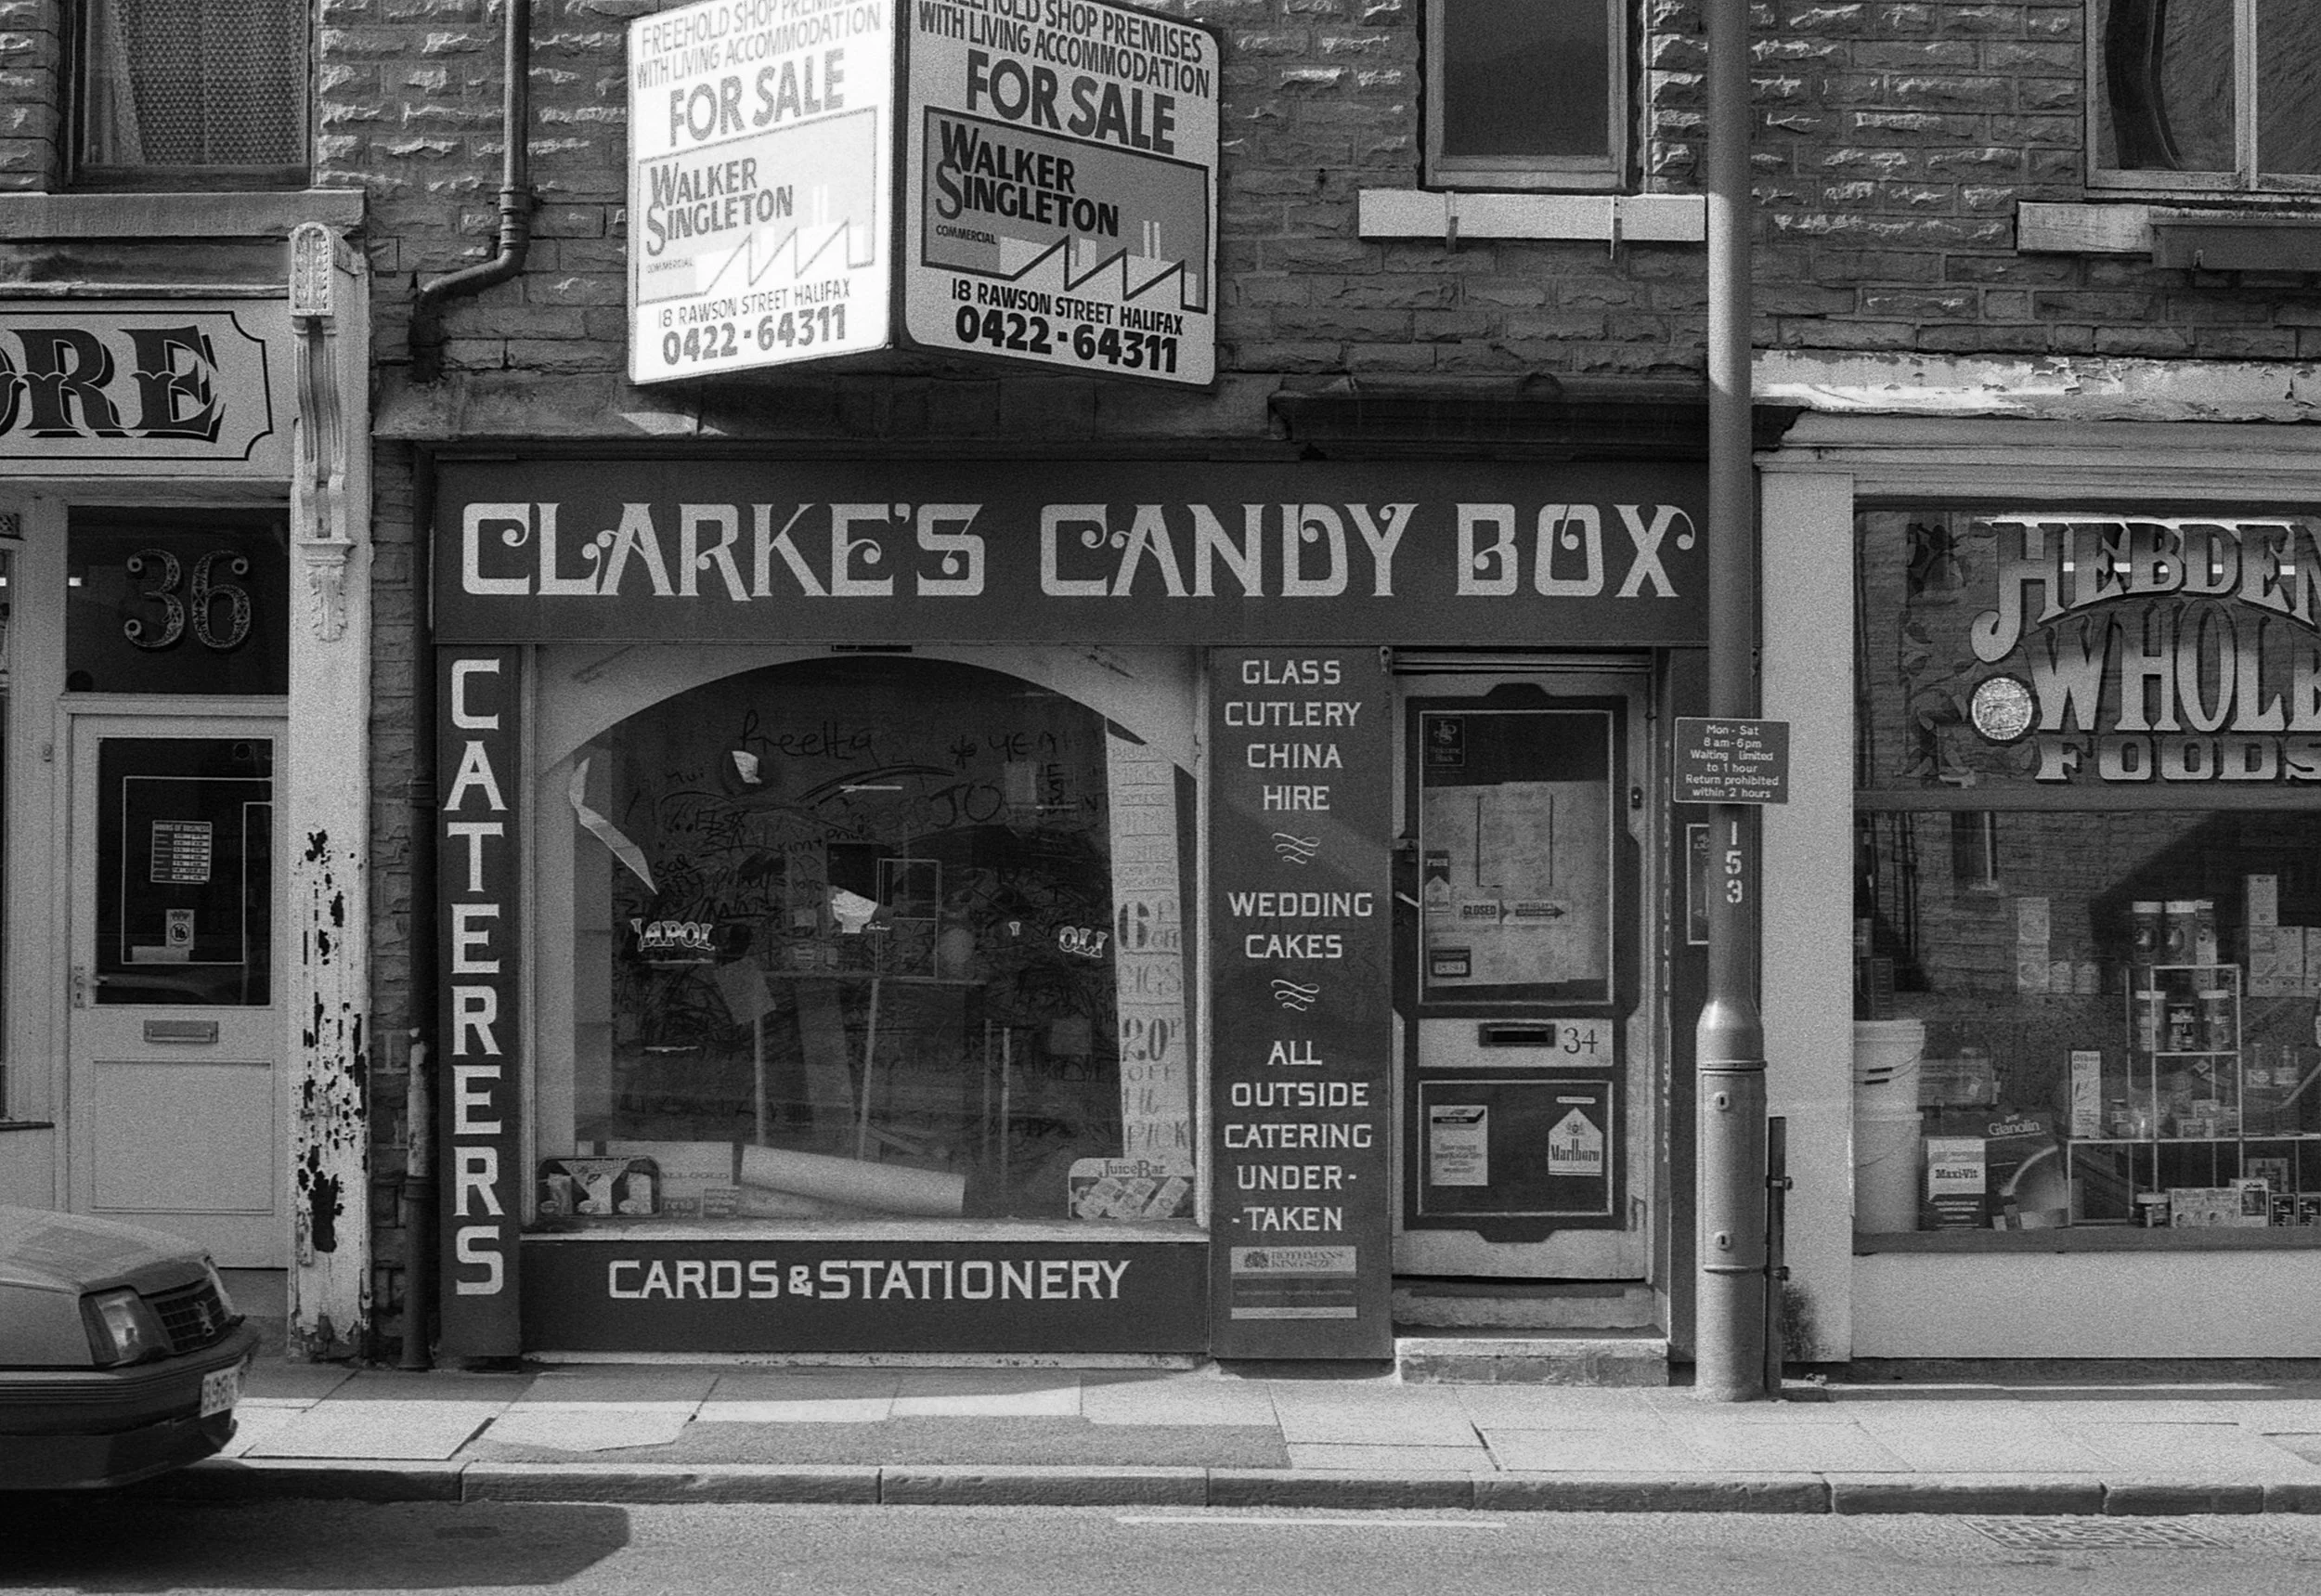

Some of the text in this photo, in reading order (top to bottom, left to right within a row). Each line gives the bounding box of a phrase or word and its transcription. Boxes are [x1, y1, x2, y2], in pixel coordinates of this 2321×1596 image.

[642, 6, 730, 58] FREEHOLD
[733, 0, 776, 32] SHOP
[1045, 0, 1098, 36] SHOP
[1103, 10, 1202, 64] PREMISES
[637, 2, 881, 89] WITH LIVING ACCOMMODATION
[918, 1, 1210, 98] WITH LIVING ACCOMMODATION
[670, 47, 845, 147] FOR SALE
[966, 48, 1175, 155] FOR SALE
[940, 119, 1076, 193] WALKER
[650, 157, 758, 206] WALKER
[936, 159, 1119, 237] SINGLETON
[646, 185, 793, 256] SINGLETON
[936, 225, 996, 245] COMMERCIAL
[647, 259, 694, 274] COMMERCIAL
[658, 279, 850, 328] 18 RAWSON STREET HALIFAX
[952, 278, 1184, 335] 18 RAWSON STREET HALIFAX
[0, 325, 226, 443] RE
[463, 502, 1695, 602] CLARKE'S CANDY BOX
[123, 549, 251, 648] 36
[1242, 659, 1341, 684] GLASS
[1225, 701, 1362, 726] CUTLERY
[1706, 725, 1729, 735] Mon
[1739, 725, 1759, 735] Sat
[1247, 744, 1342, 768] CHINA
[1690, 749, 1773, 761] Waiting limited
[1706, 762, 1757, 772] to 1 hour
[2034, 734, 2321, 781] FOODS
[1686, 774, 1779, 786] Return prohibited
[1692, 786, 1771, 798] within 2 hours
[1263, 785, 1330, 810] HIRE
[1227, 891, 1373, 916] WEDDING
[1463, 904, 1496, 915] CLOSED
[1245, 934, 1343, 958] CAKES
[443, 658, 509, 1296] CATERERS
[1267, 1041, 1323, 1066] ALL
[1563, 1028, 1598, 1054] 34
[1231, 1082, 1369, 1107] OUTSIDE
[1225, 1123, 1372, 1148] CATERING
[1550, 1138, 1600, 1161] Marlboro
[609, 1260, 1132, 1300] CARDS & STATIONERY
